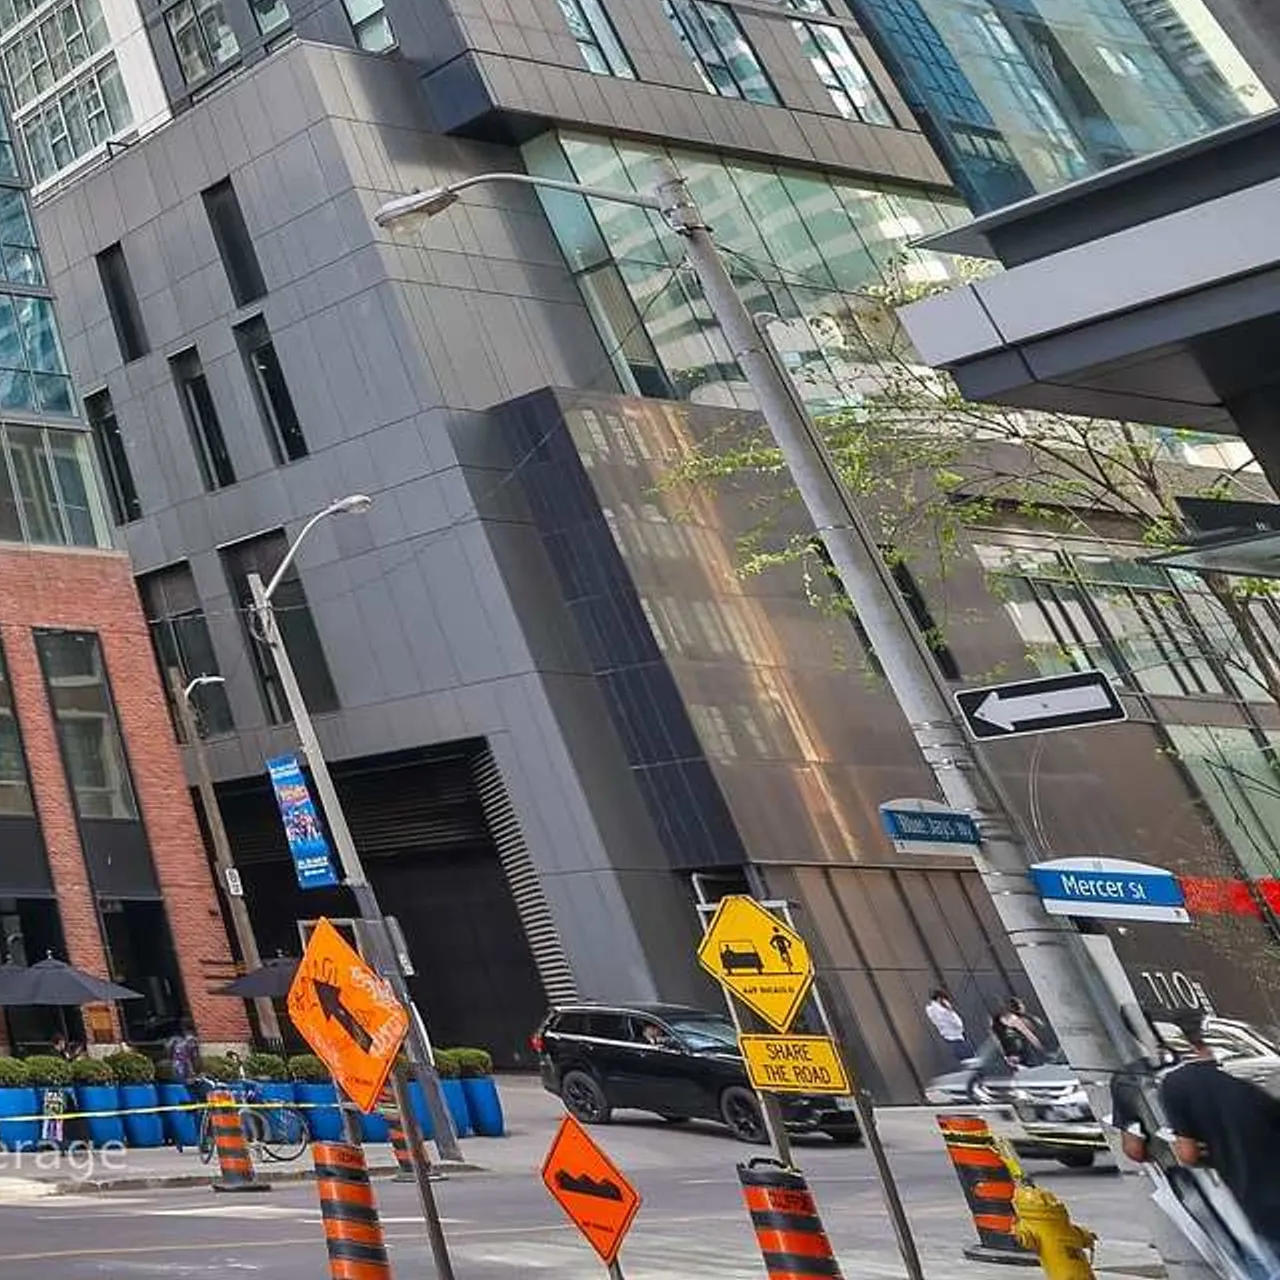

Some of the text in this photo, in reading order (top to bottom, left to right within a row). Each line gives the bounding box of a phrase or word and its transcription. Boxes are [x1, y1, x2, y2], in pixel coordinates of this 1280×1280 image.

[1060, 873, 1148, 901] Mercer St
[765, 1043, 813, 1062] SHARE
[762, 1064, 832, 1085] THE ROAD
